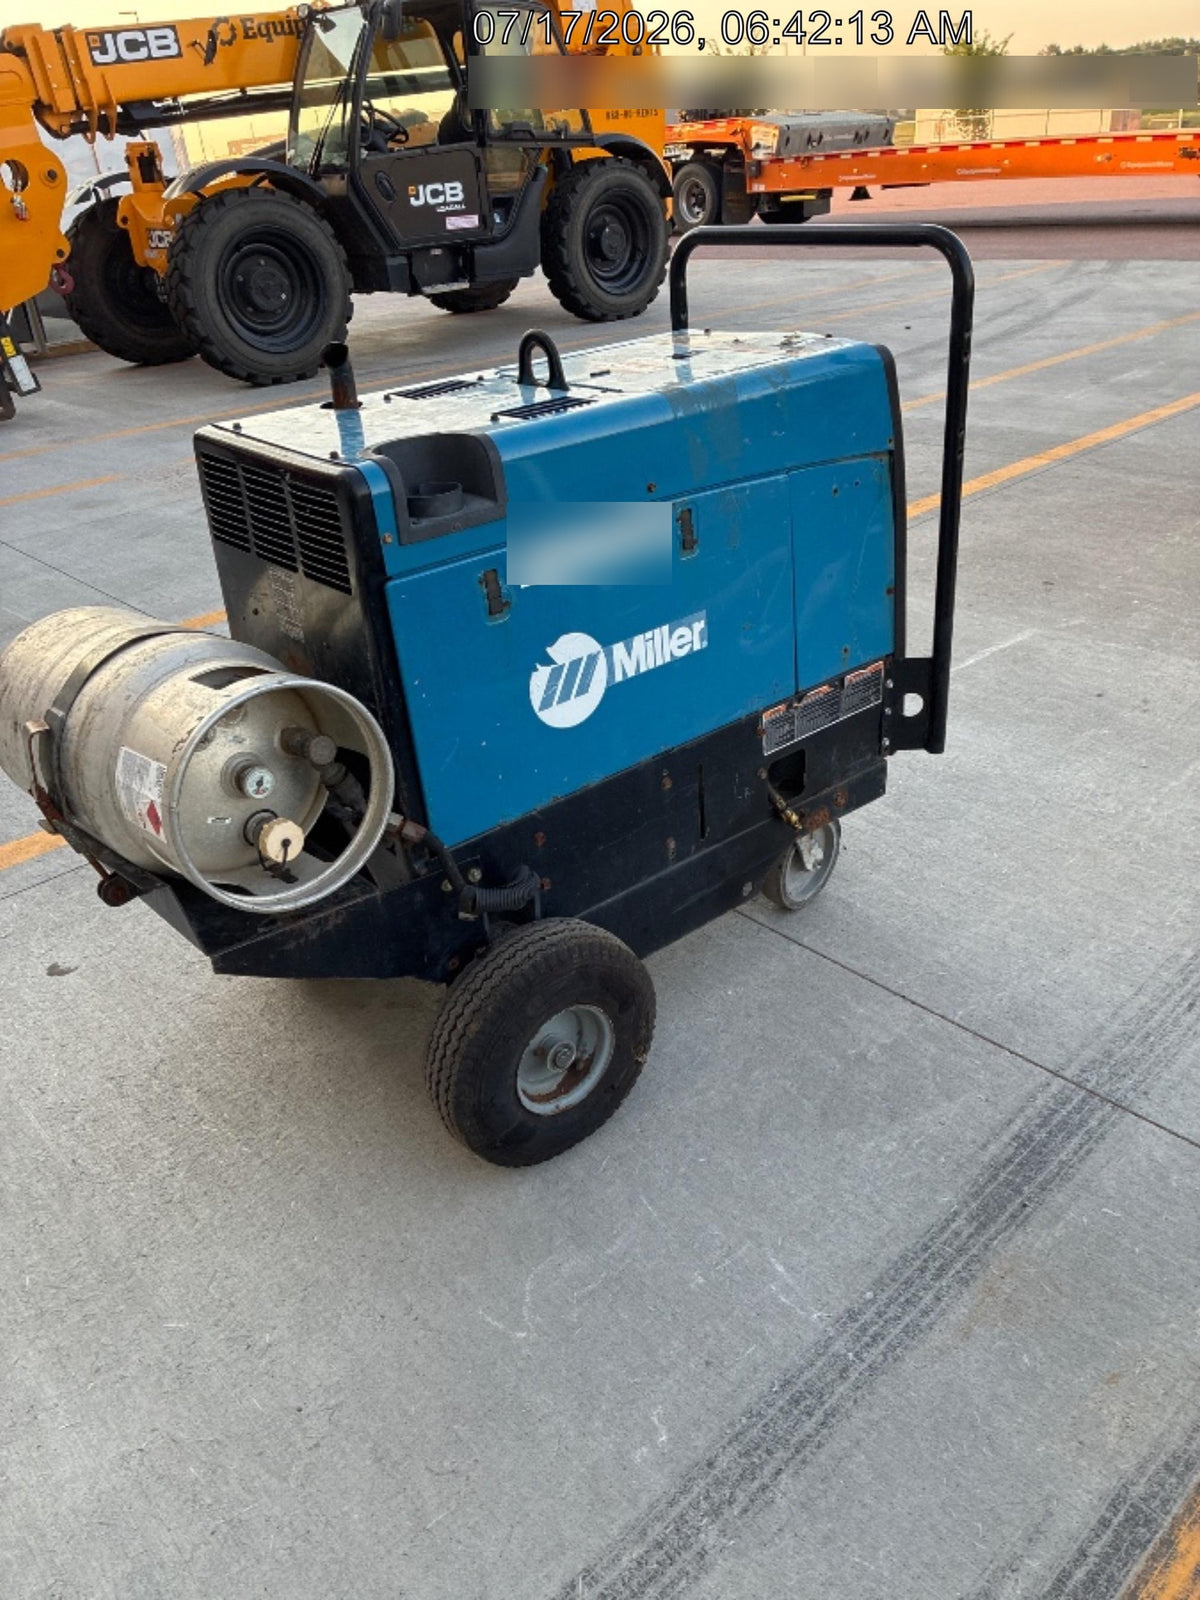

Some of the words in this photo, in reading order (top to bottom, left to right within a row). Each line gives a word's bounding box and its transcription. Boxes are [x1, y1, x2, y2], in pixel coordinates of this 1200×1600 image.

[91, 27, 179, 64] JCB
[409, 181, 465, 207] JCB
[612, 619, 705, 683] Miller
